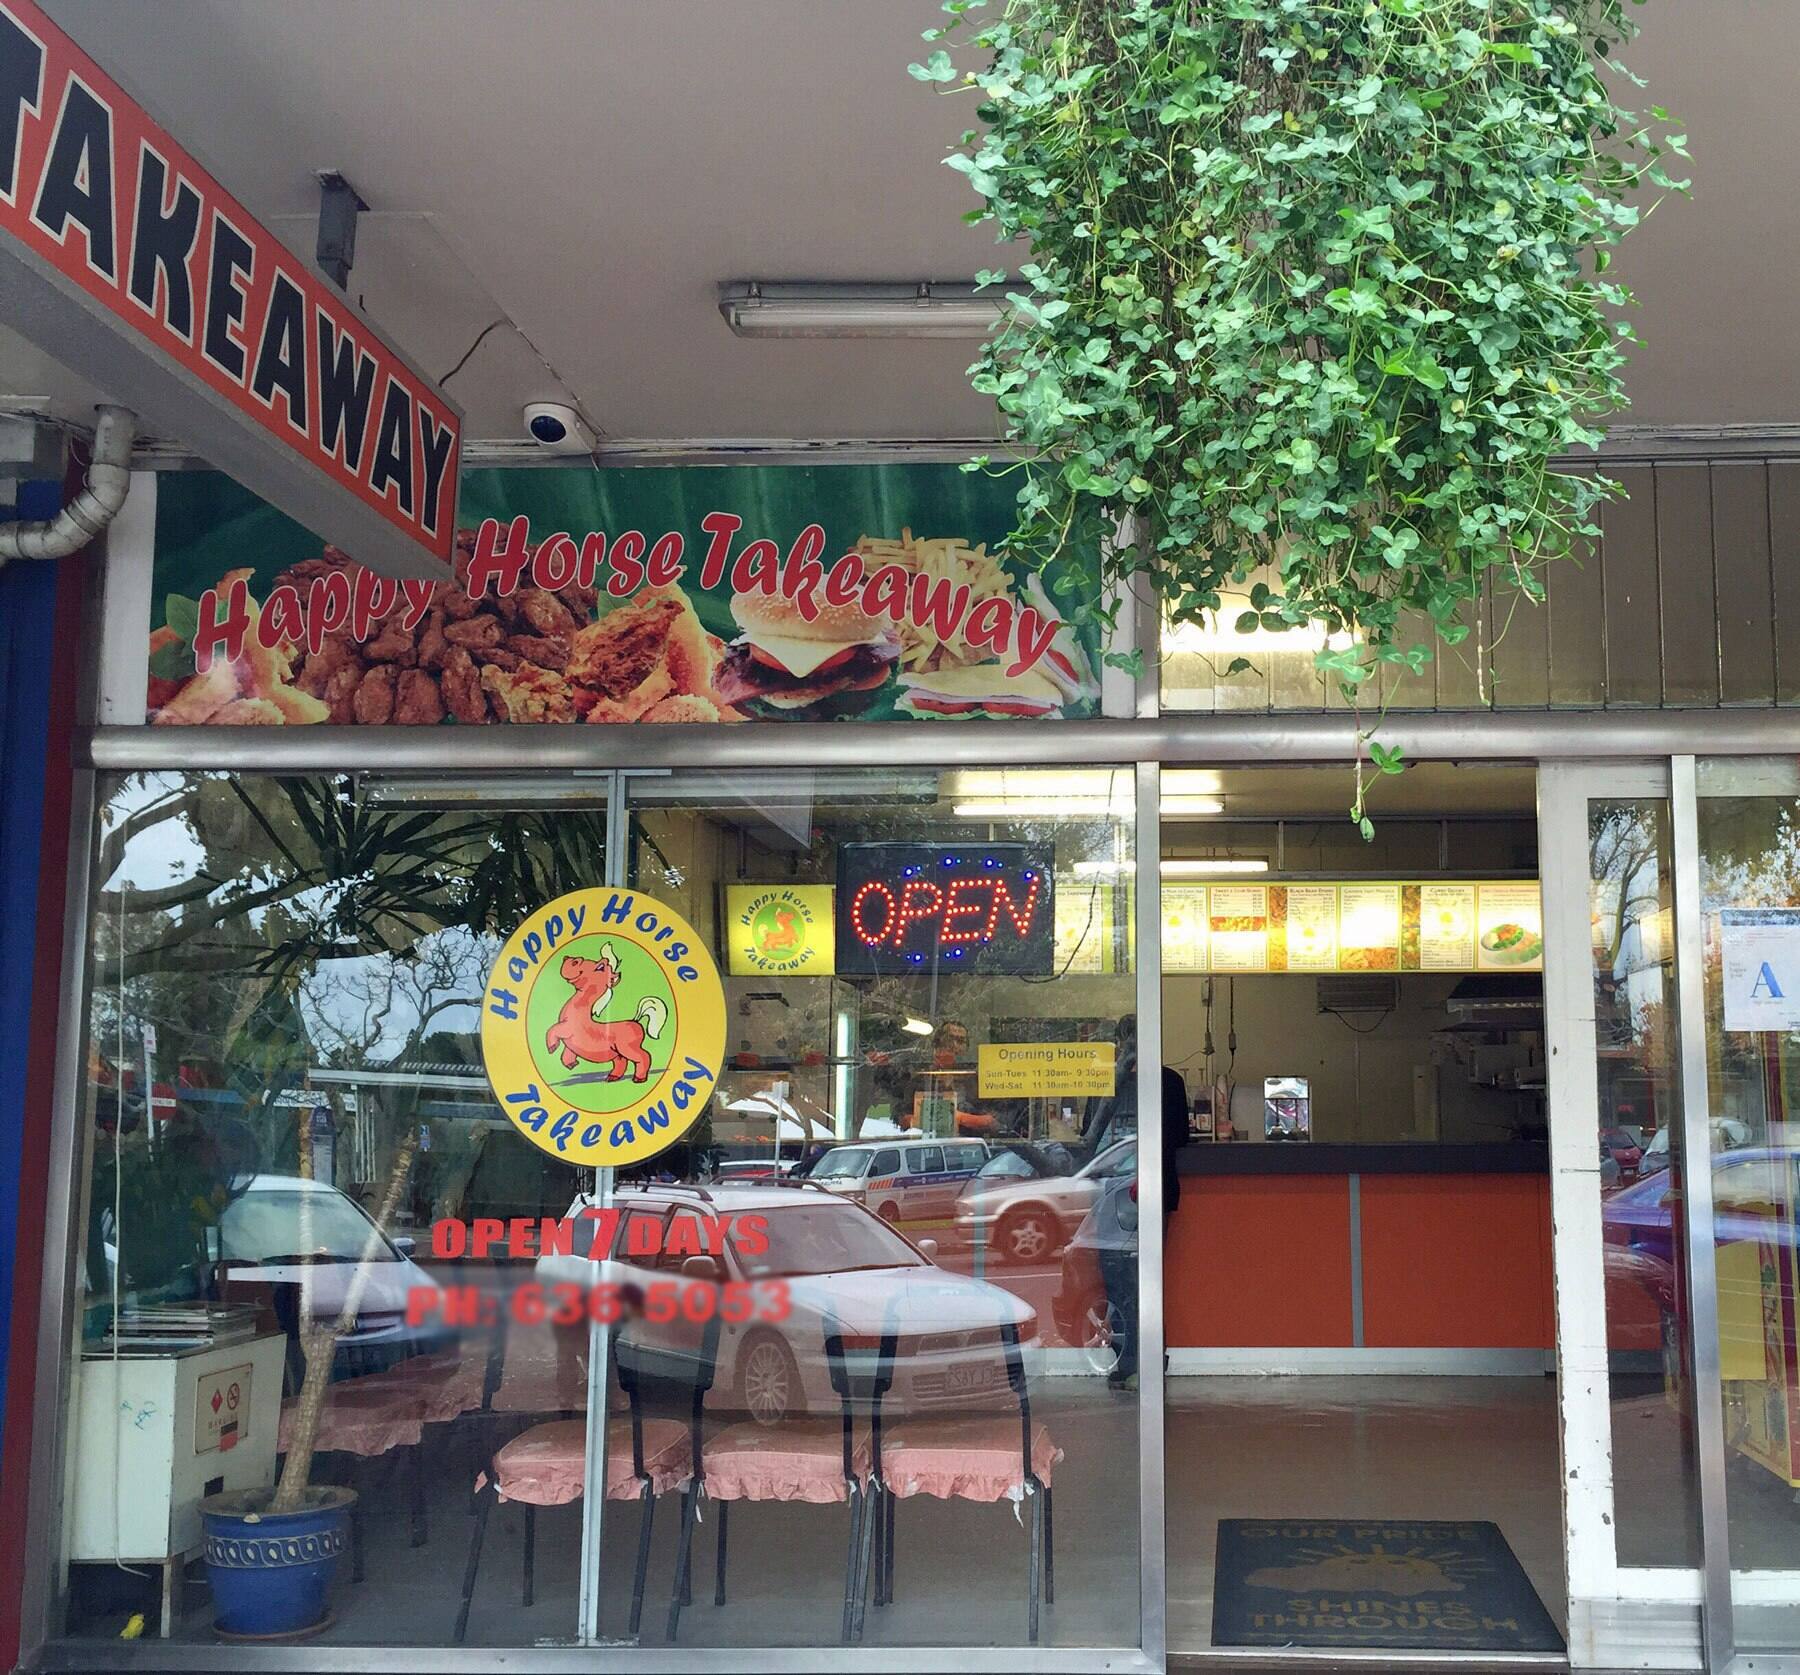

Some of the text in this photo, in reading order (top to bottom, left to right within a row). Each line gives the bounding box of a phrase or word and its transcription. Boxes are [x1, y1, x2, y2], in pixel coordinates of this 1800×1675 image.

[192, 512, 1062, 678] Happy Horse Takeaway
[741, 890, 814, 926] Happy Horse
[851, 876, 1041, 946] OPEN
[490, 894, 699, 1021] Happy Horse
[744, 947, 816, 971] Takeaway
[1750, 961, 1786, 998] A
[998, 1048, 1097, 1062] Opening Hours
[505, 1056, 714, 1151] Takeaway
[432, 1207, 770, 1261] OPEN 7 DAYS
[509, 1281, 623, 1326] 636
[644, 1279, 794, 1324] 5053
[1250, 1614, 1520, 1632] THROUGH
[1288, 1599, 1473, 1615] SHINES
